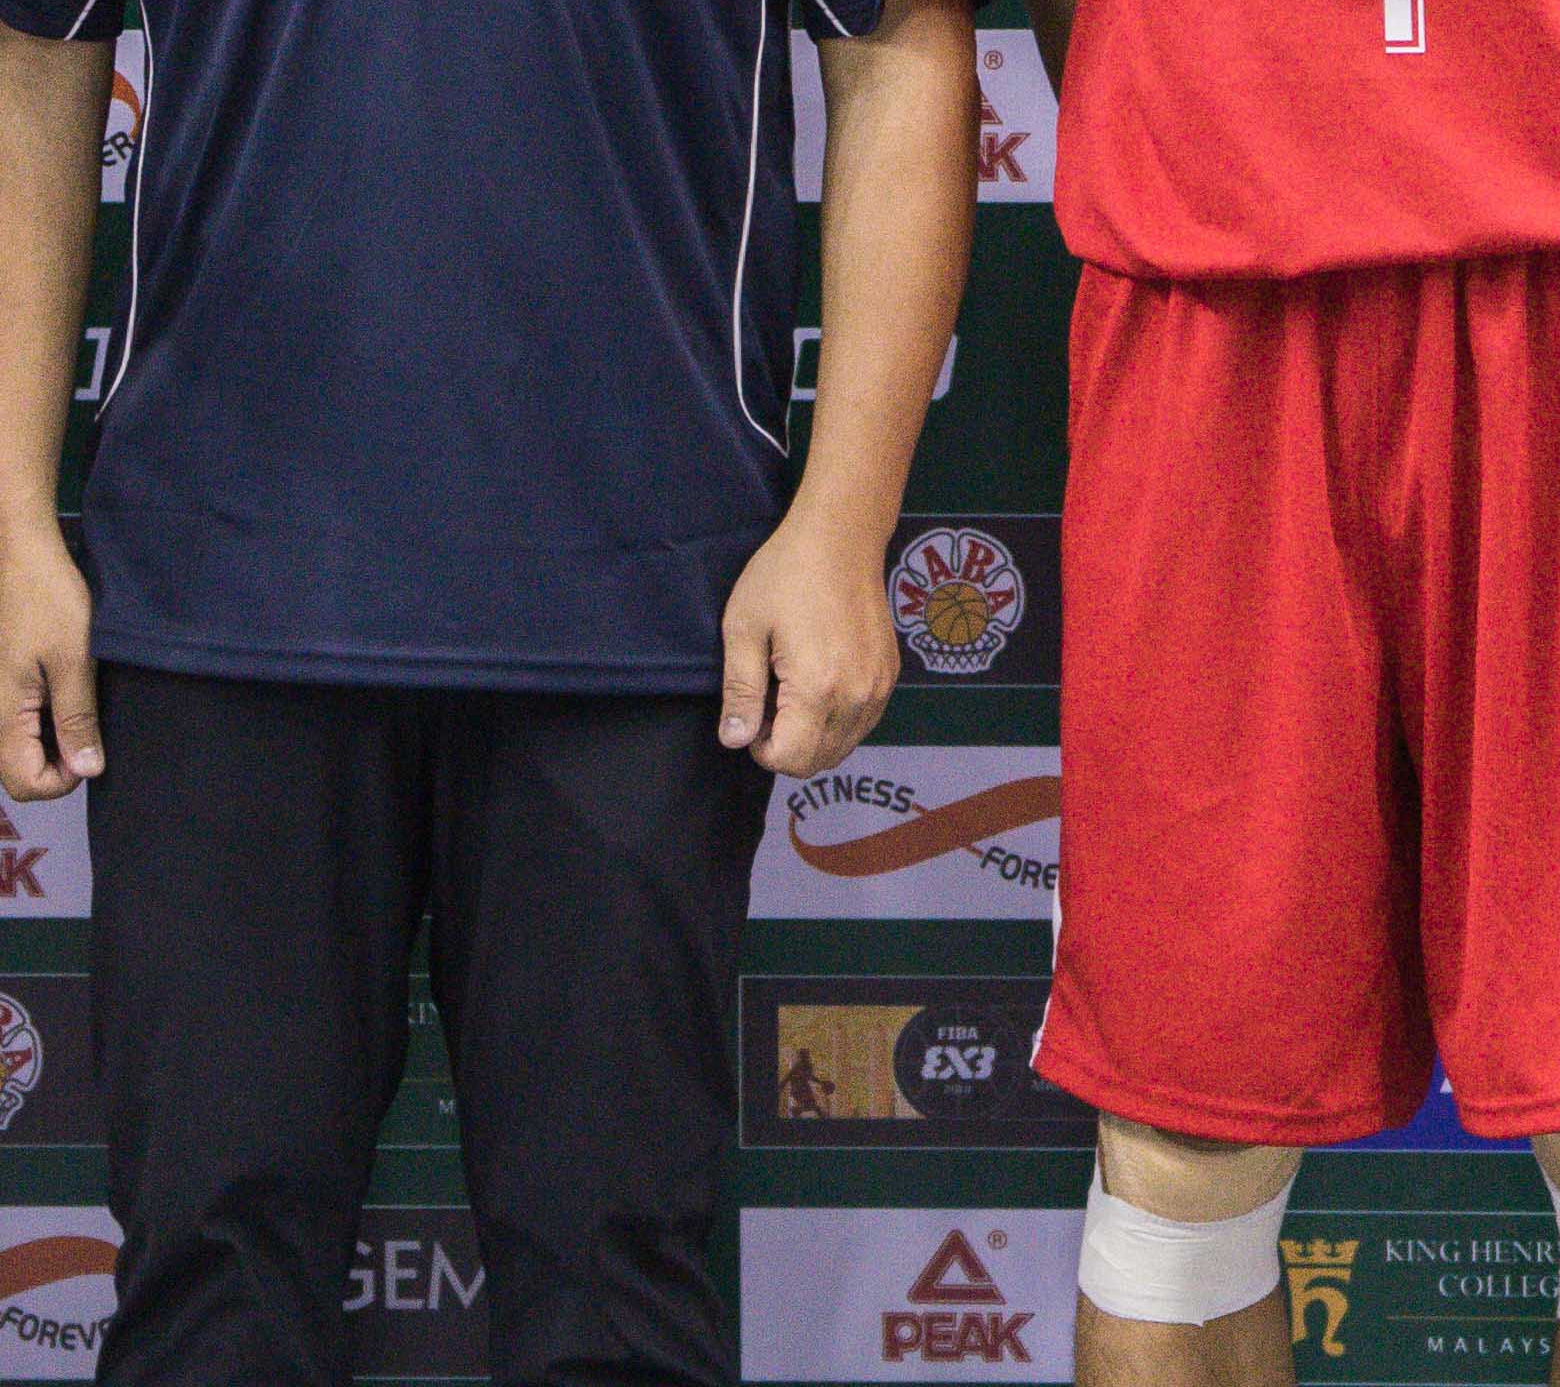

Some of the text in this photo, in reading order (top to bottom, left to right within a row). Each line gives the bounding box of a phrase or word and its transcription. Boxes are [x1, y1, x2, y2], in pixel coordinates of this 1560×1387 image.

[898, 540, 1010, 619] MABA
[787, 776, 915, 820] FITNESS
[883, 1312, 1034, 1362] PEAK
